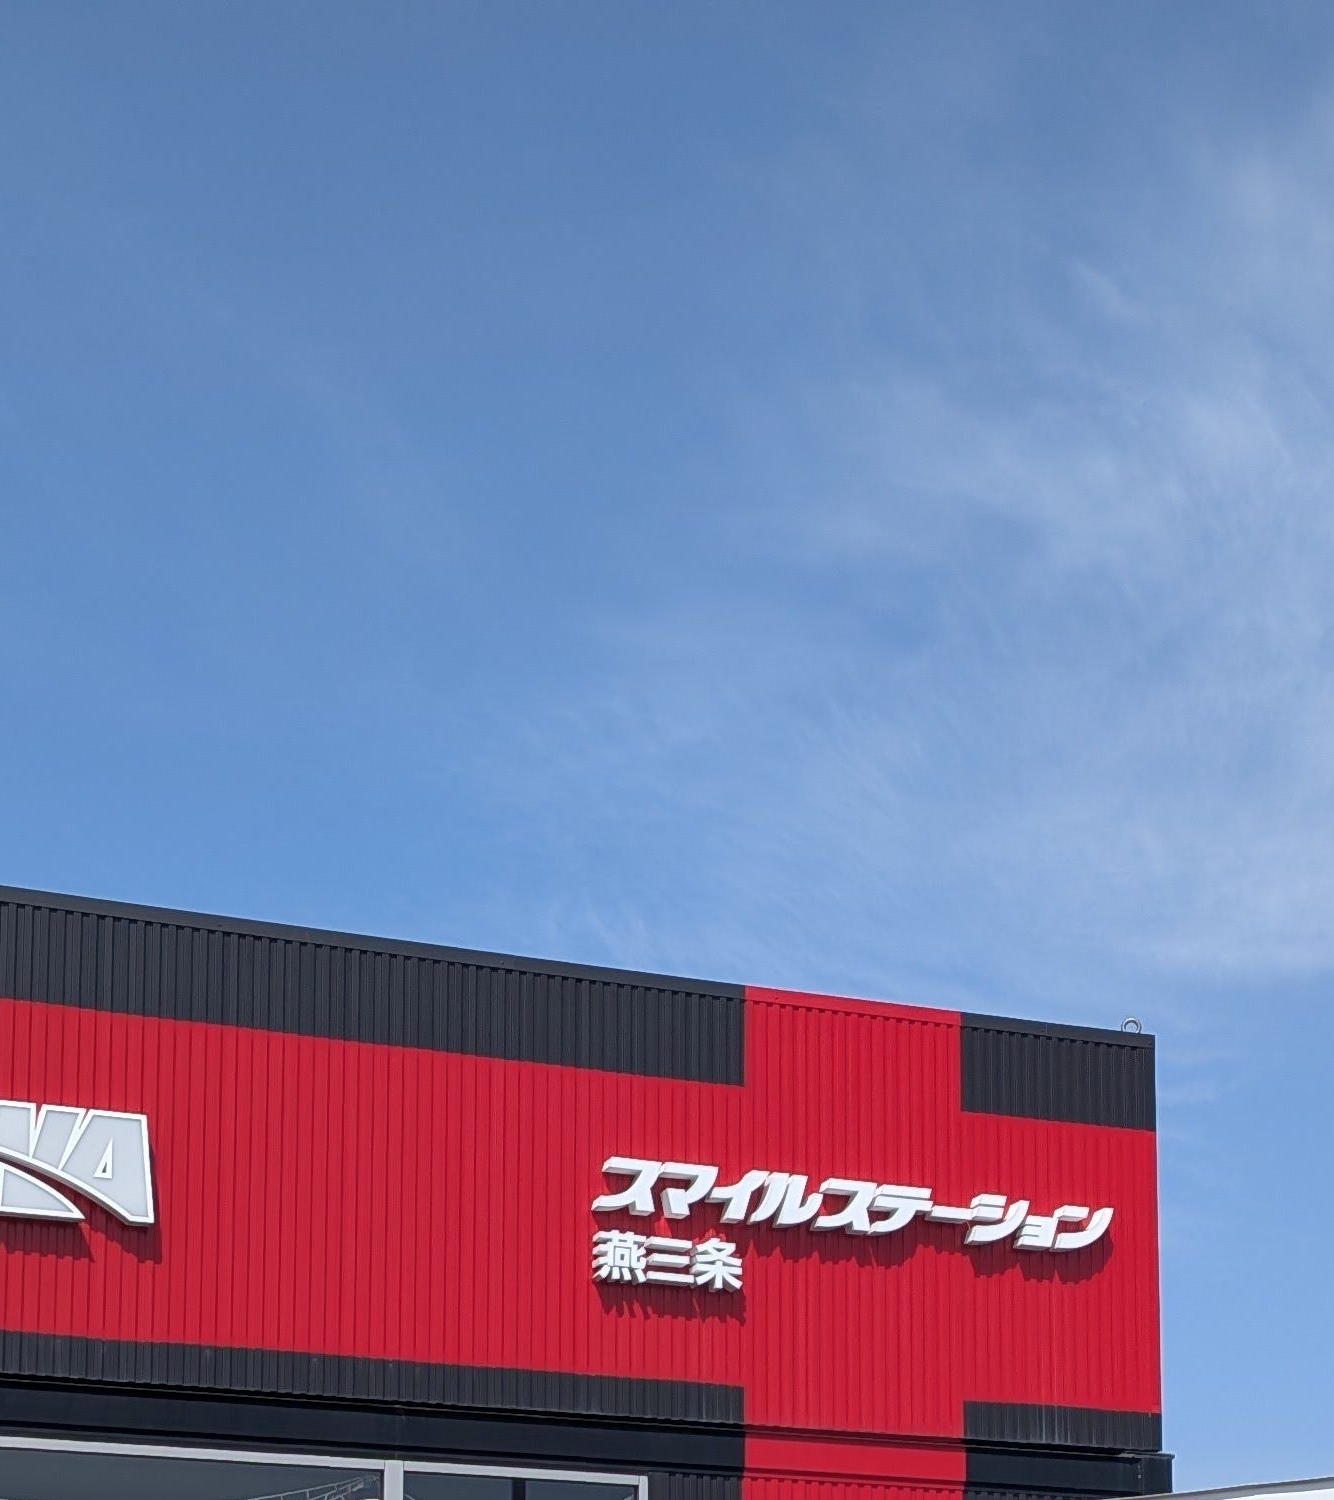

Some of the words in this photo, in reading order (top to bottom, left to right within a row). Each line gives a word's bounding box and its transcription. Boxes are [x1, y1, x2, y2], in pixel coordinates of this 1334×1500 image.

[591, 1156, 1114, 1252] スマイルステーション
[592, 1230, 744, 1291] 燕三条
